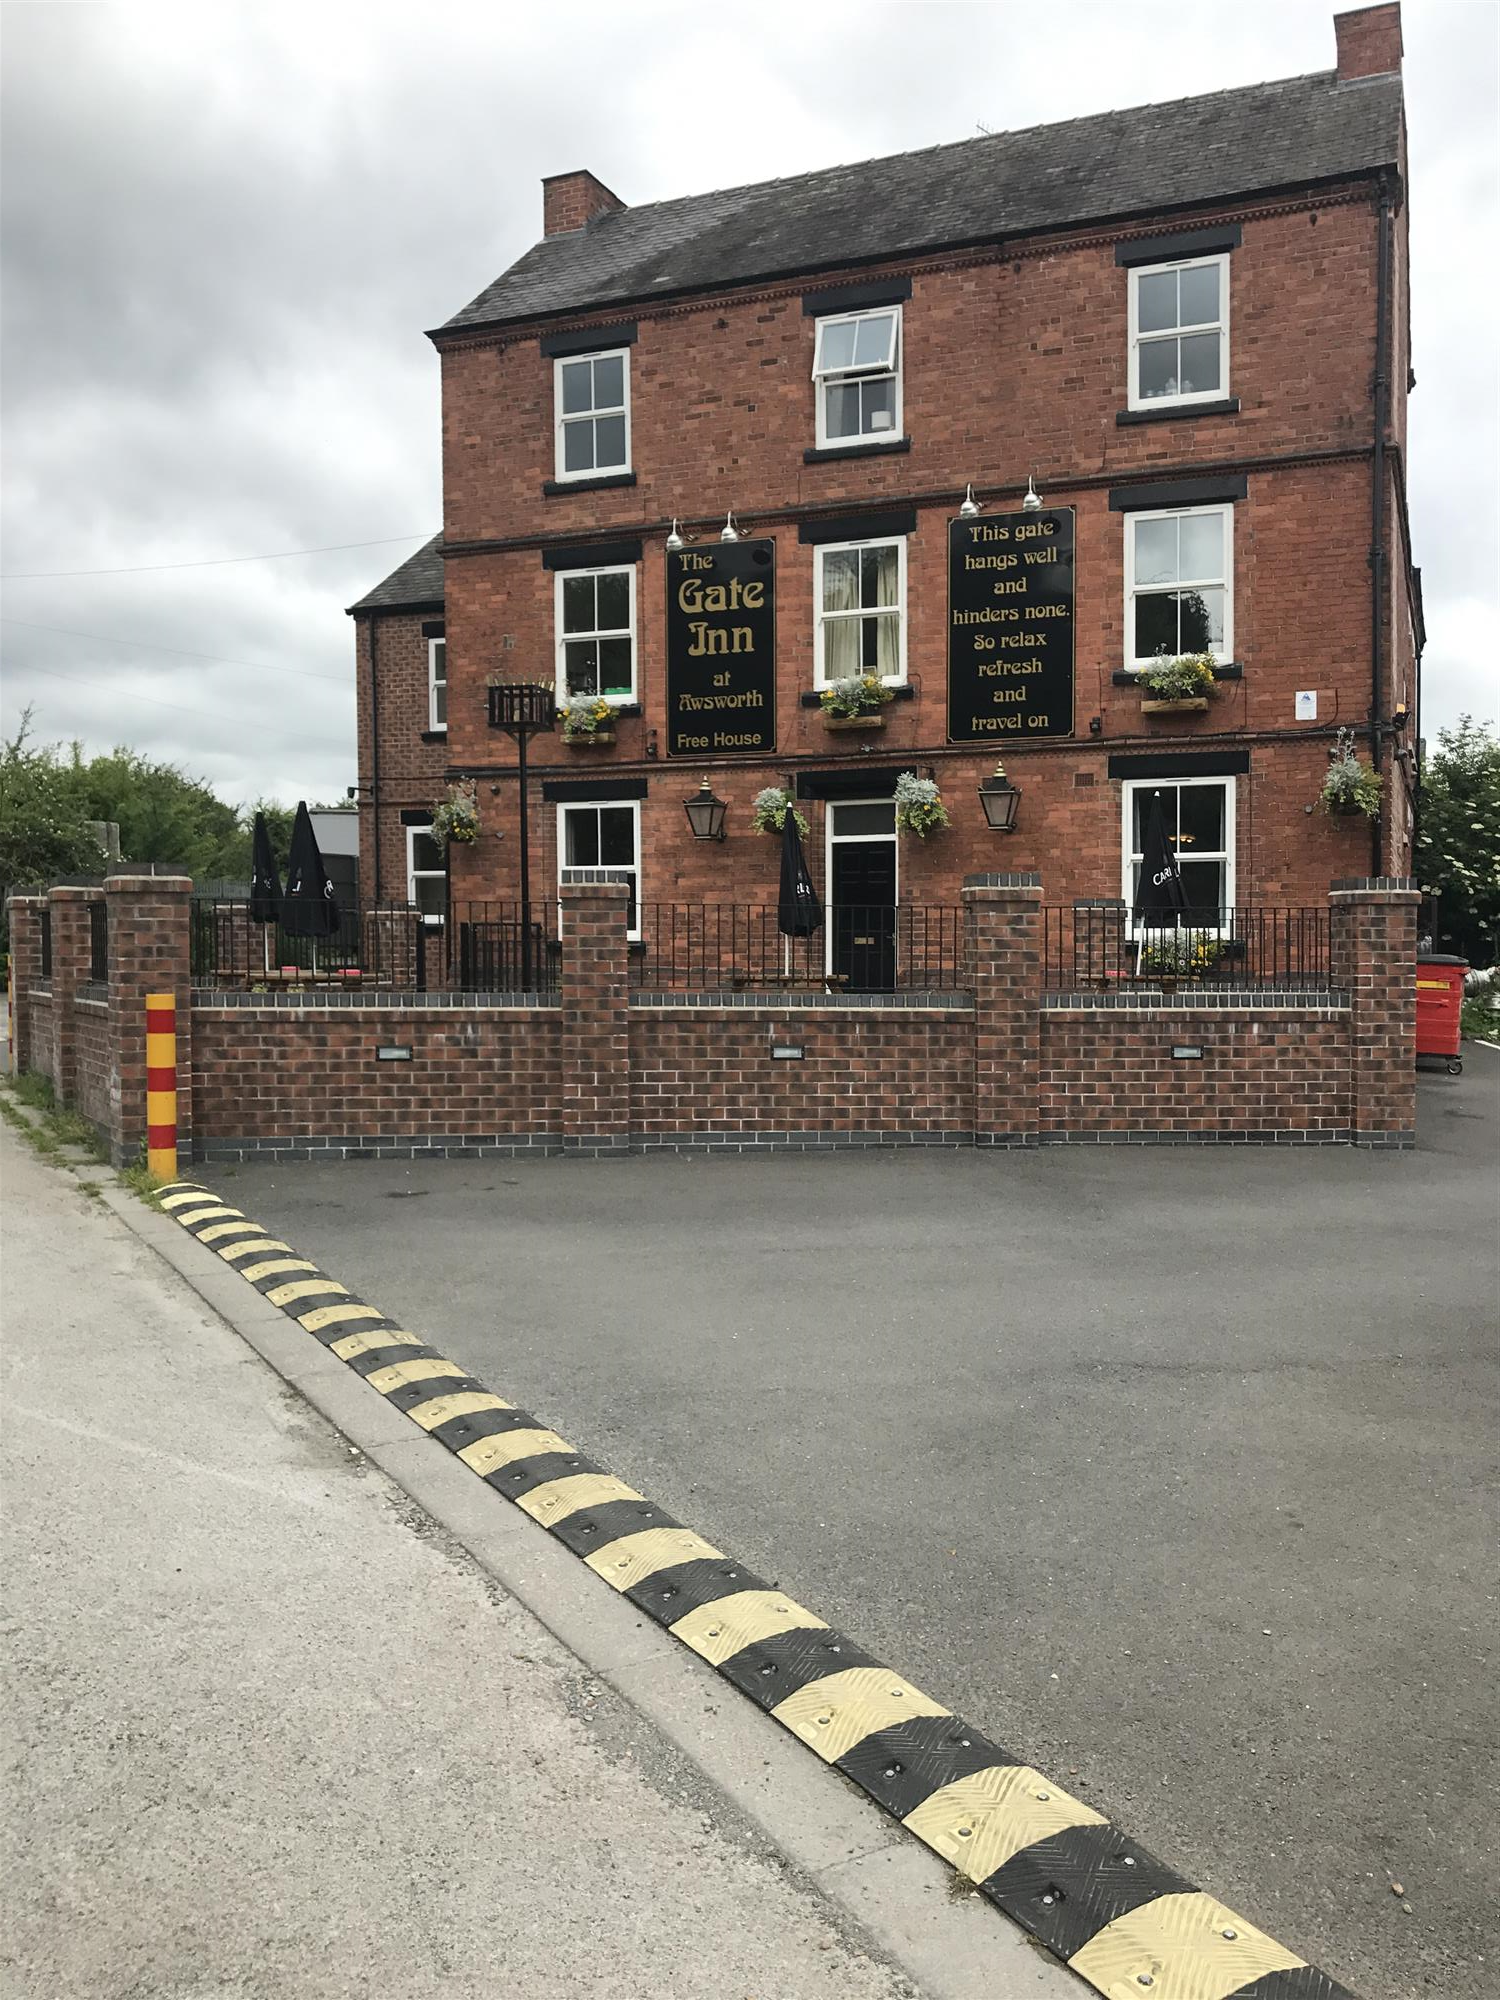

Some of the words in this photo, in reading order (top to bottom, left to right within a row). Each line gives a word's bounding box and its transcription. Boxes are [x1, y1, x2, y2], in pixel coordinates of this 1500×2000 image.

[969, 526, 1010, 542] This
[1015, 521, 1054, 541] gate
[679, 553, 713, 571] The
[965, 554, 1018, 570] hangs
[1024, 547, 1058, 565] well
[994, 577, 1028, 594] and
[678, 576, 765, 614] Gate
[953, 607, 1019, 625] hinders
[1025, 604, 1070, 619] none.
[688, 622, 755, 657] Inn
[973, 635, 995, 650] So
[1001, 632, 1047, 648] relax
[978, 658, 1043, 677] refresh
[713, 671, 731, 687] at
[679, 690, 763, 711] Awsworth
[993, 686, 1027, 702] and
[971, 713, 1022, 731] travel
[1028, 714, 1049, 728] on
[677, 734, 709, 748] Free
[714, 732, 762, 747] House
